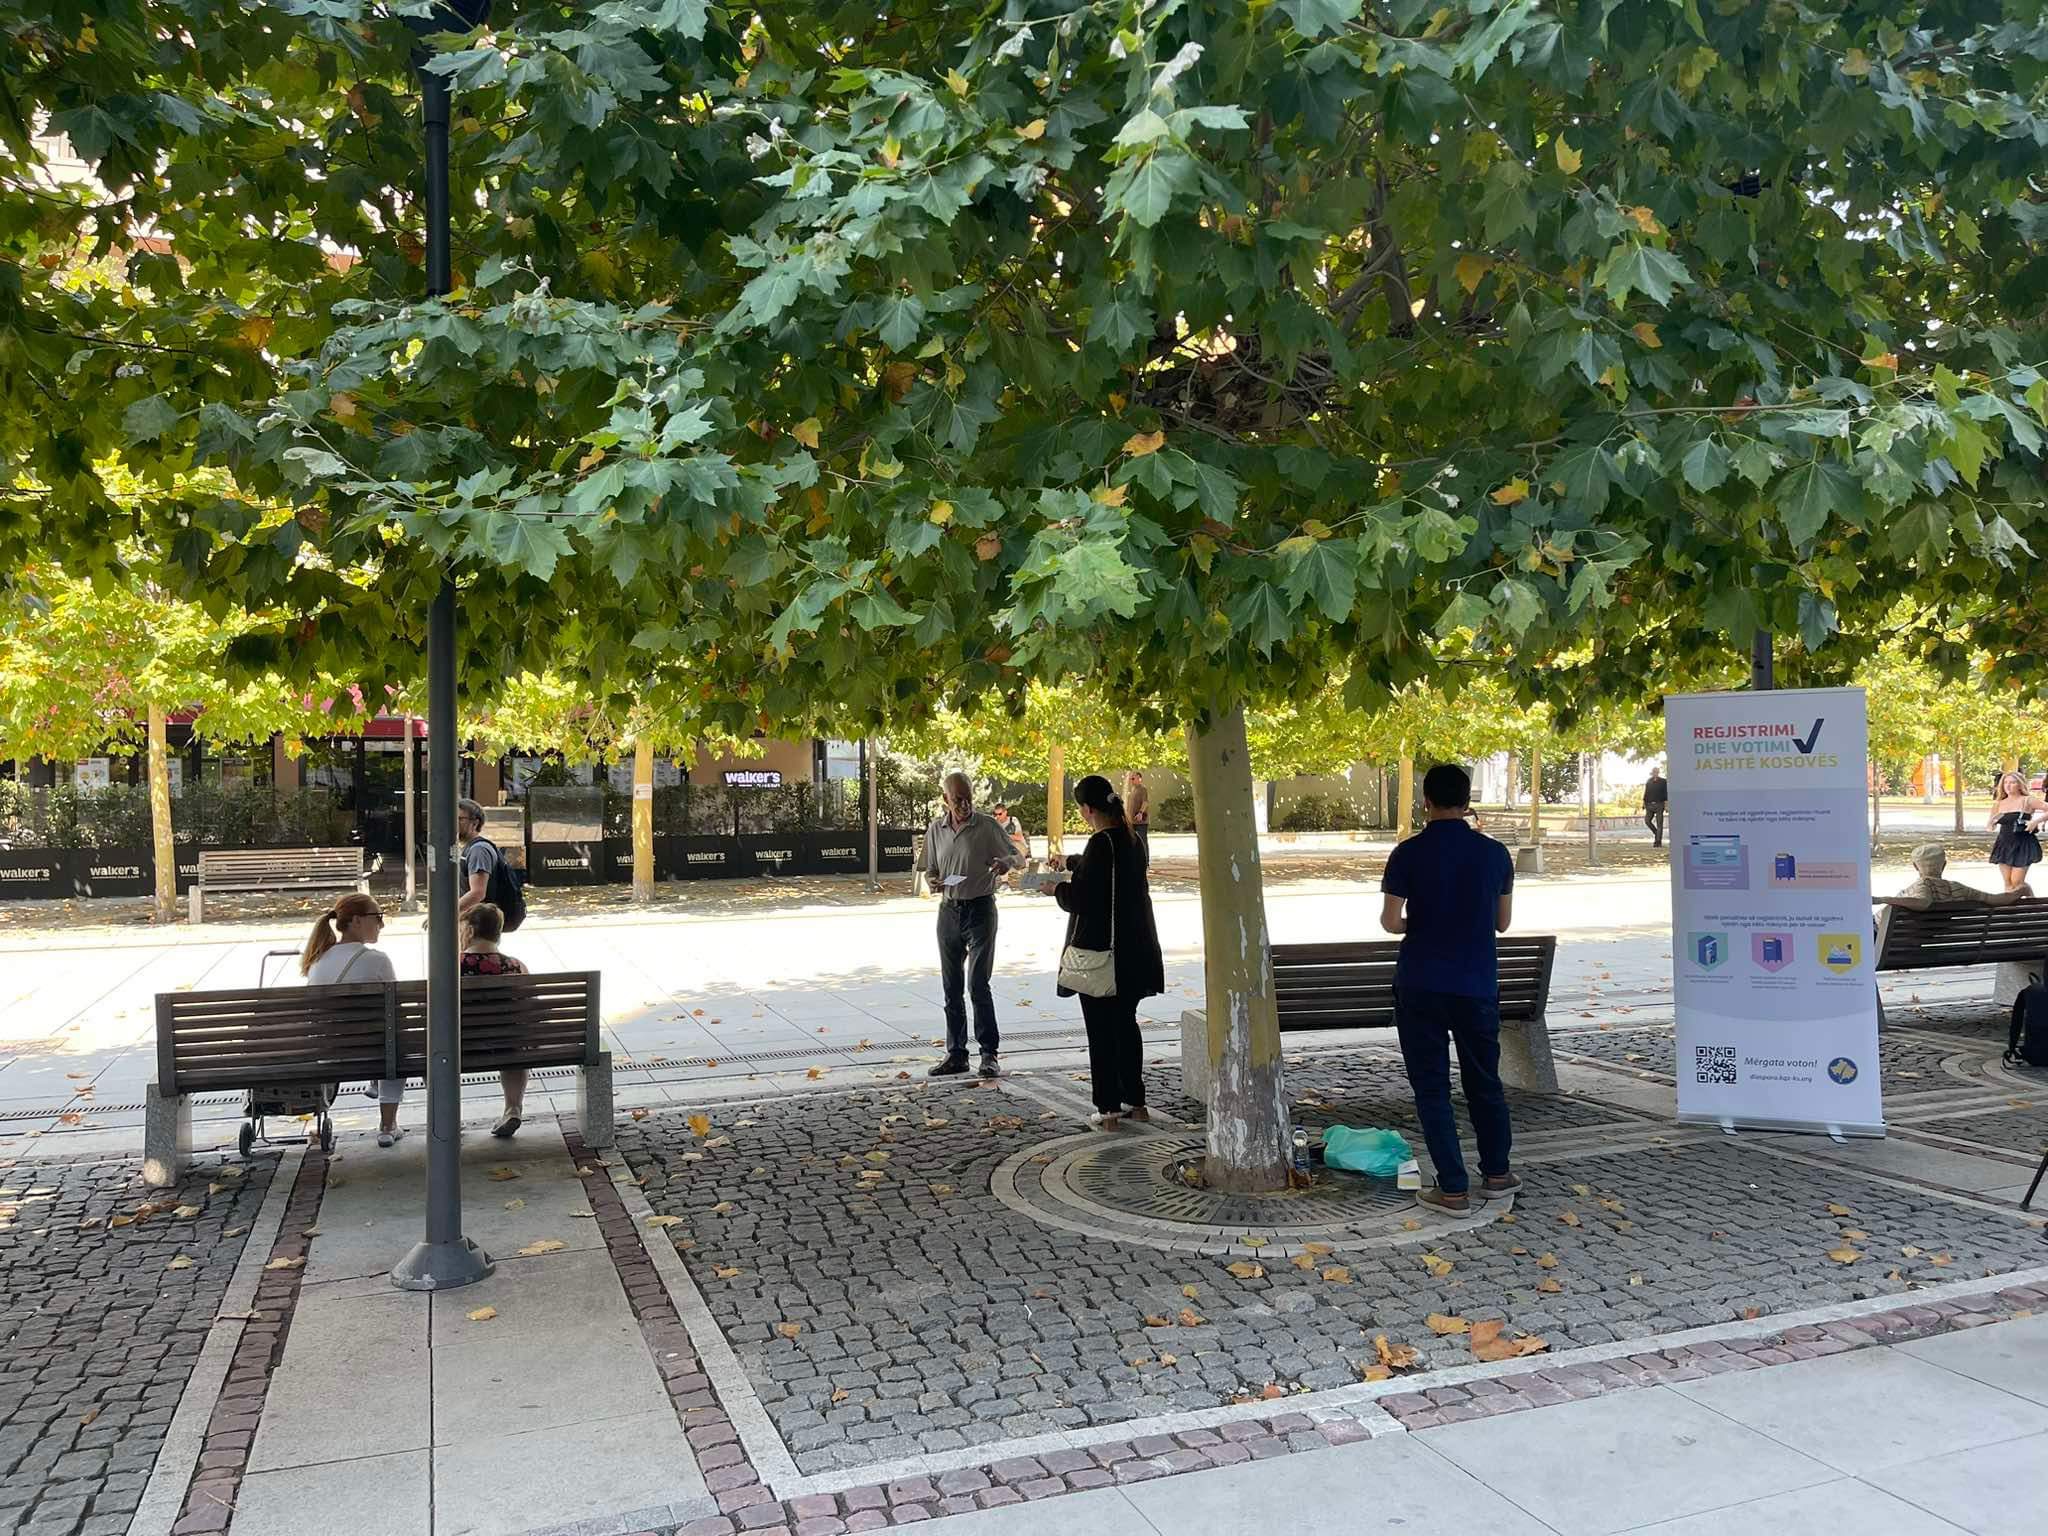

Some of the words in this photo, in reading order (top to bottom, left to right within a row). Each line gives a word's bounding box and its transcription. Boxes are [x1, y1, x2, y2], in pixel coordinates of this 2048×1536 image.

[1694, 724, 1795, 739] REGJISTRIMI
[1695, 742, 1726, 754] DHE
[1731, 740, 1790, 753] VOTIMI
[1760, 752, 1838, 768] KOSOVËS
[725, 771, 780, 783] walker's
[884, 846, 913, 854] walker
[0, 868, 50, 878] walker's
[90, 866, 139, 876] walker's
[1786, 1059, 1818, 1068] voton!
